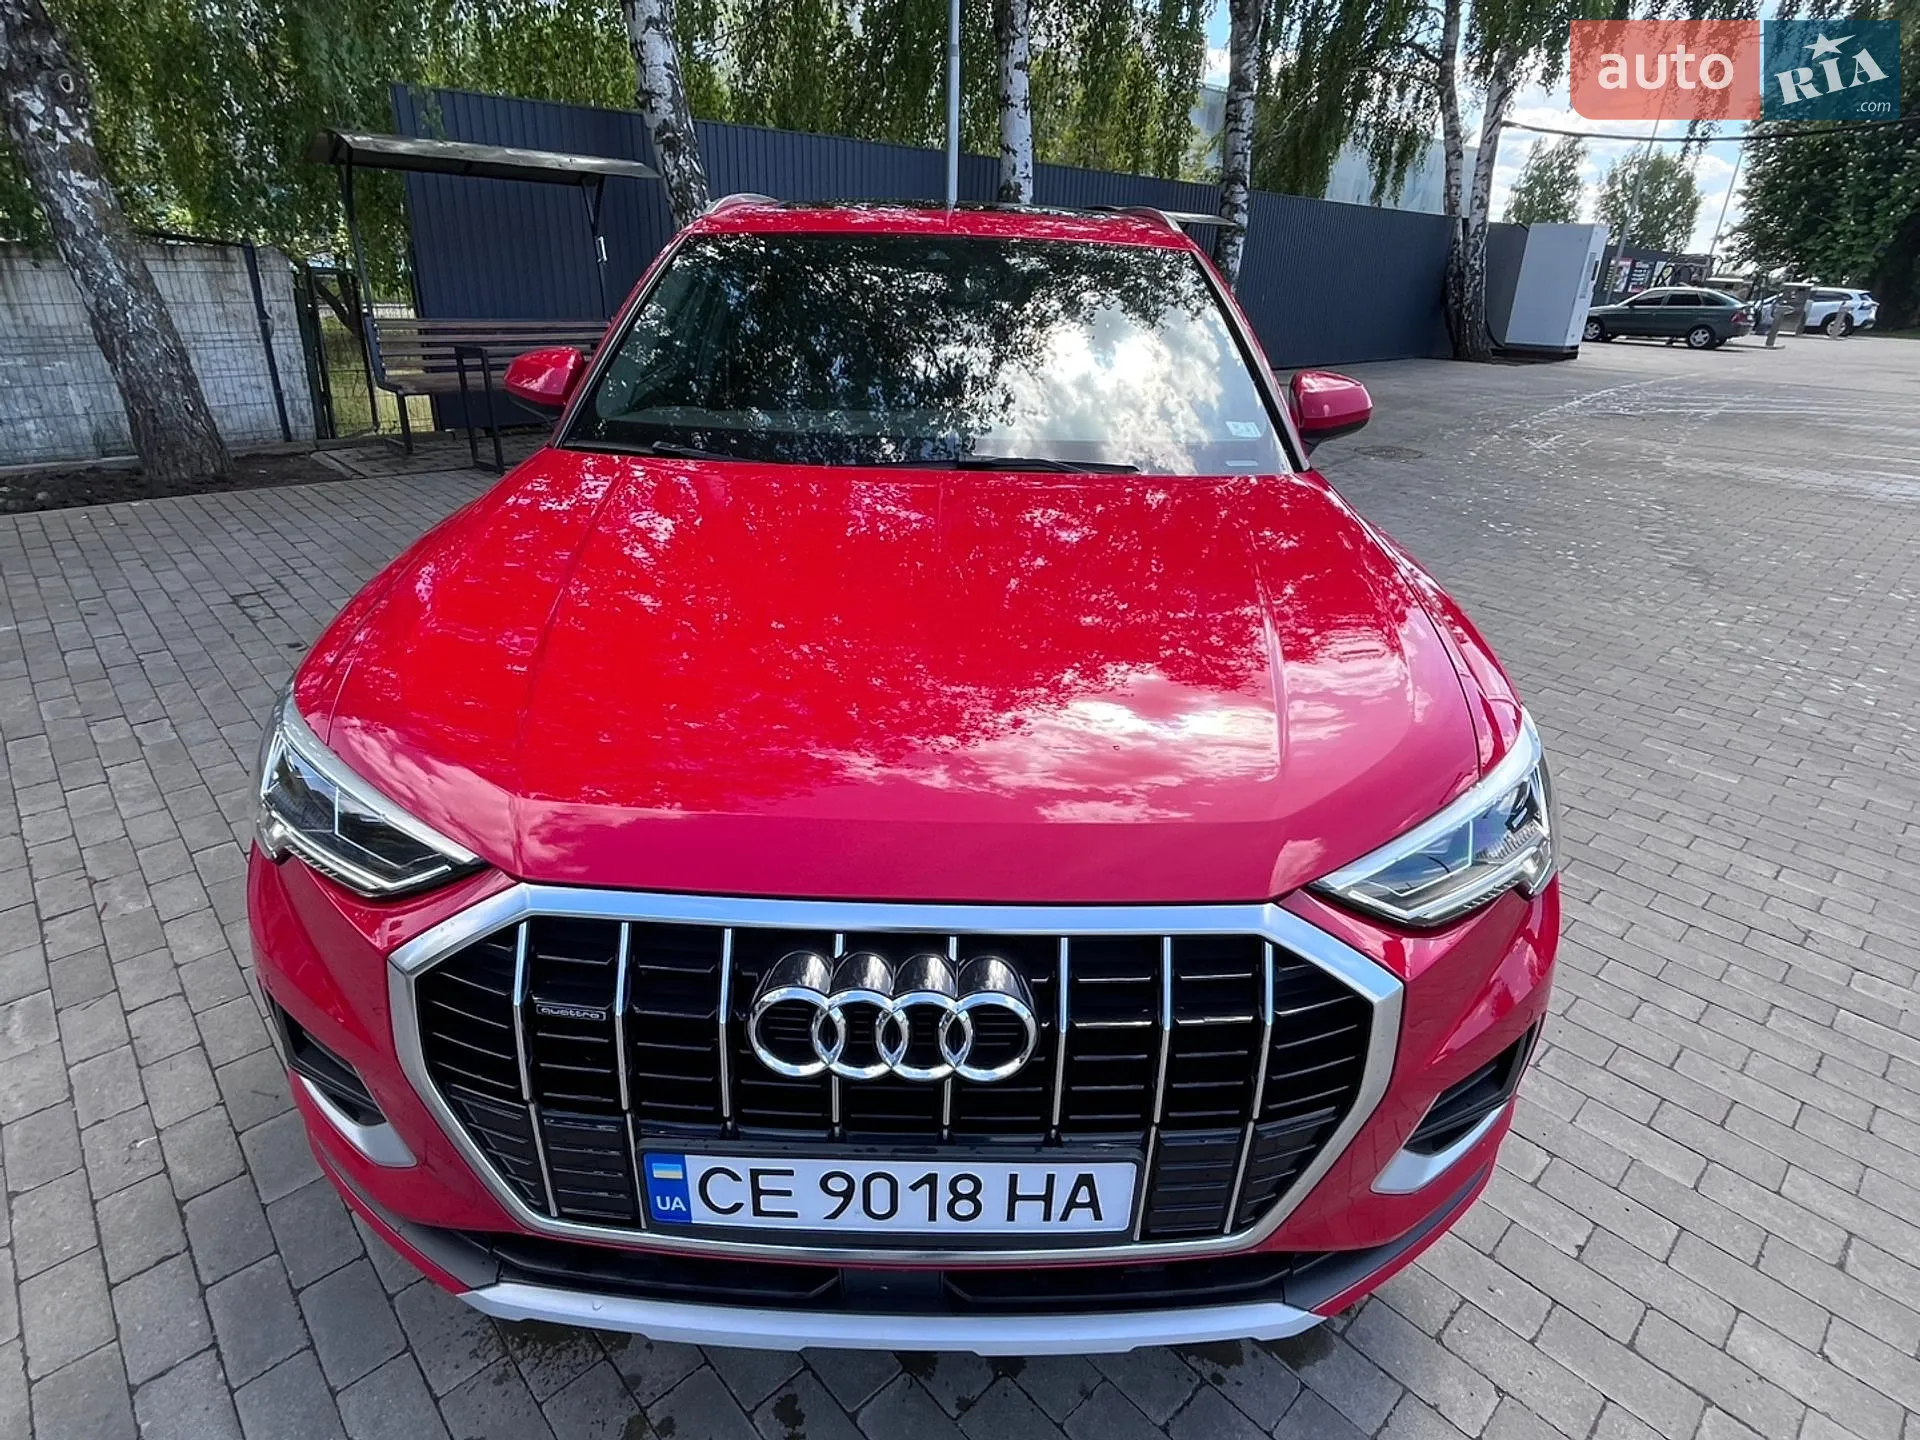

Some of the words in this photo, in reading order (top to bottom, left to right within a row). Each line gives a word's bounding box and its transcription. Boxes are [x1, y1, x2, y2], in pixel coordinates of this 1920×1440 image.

[541, 1007, 600, 1019] quattro
[698, 1166, 799, 1219] CE
[818, 1171, 984, 1222] 9018
[1006, 1173, 1103, 1222] HA
[657, 1195, 687, 1212] UA
